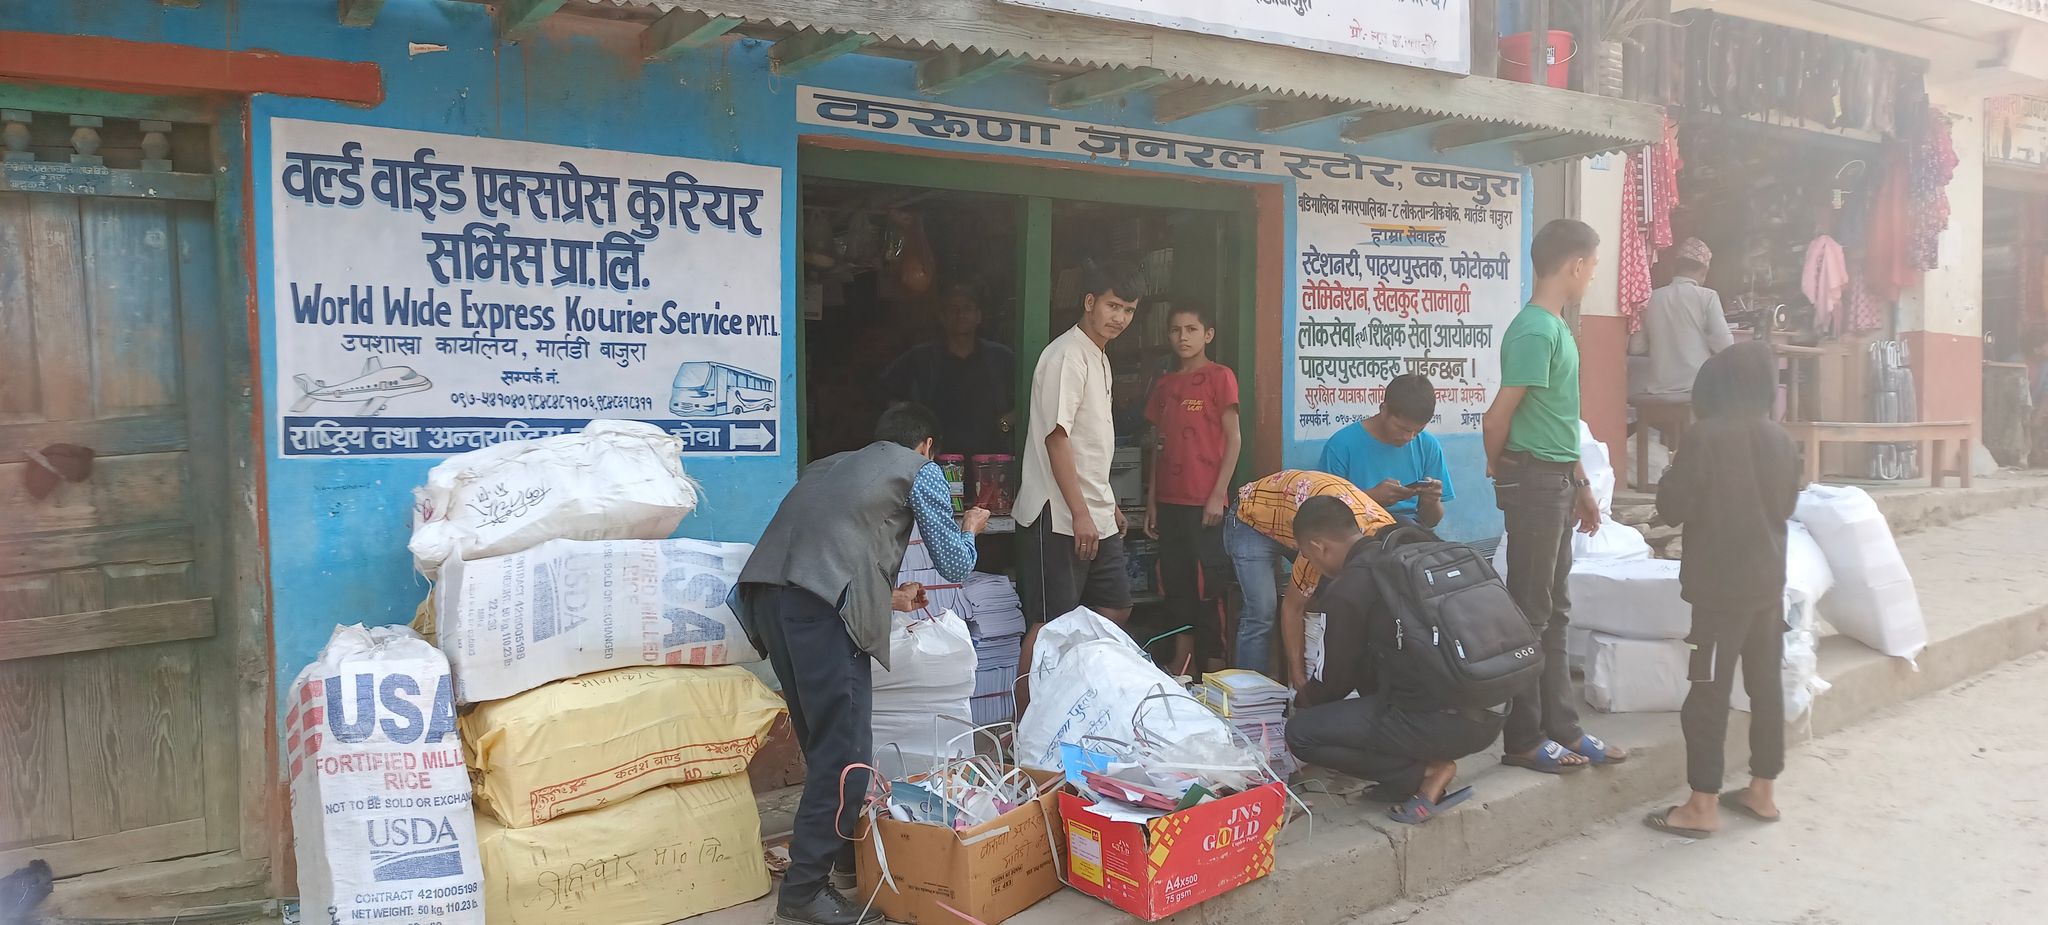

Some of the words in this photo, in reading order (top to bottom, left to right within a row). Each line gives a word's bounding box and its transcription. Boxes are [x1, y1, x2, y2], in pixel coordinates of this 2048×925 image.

[1074, 126, 1264, 170] जनरल
[1280, 154, 1402, 190] स्टोर,
[1411, 166, 1521, 205] बाजुरा
[282, 141, 365, 207] वर्ल्ड
[370, 147, 467, 221] वाईड
[471, 161, 620, 226] एक्सप्रेस
[628, 171, 764, 240] कुरियर
[422, 222, 547, 286] सर्भिस
[1302, 244, 1363, 282] स्टेशनरी,
[1449, 250, 1511, 280] फोटोकपी
[290, 282, 374, 326] World
[383, 286, 451, 328] Wide
[460, 288, 556, 338] Express
[565, 295, 658, 333] Kourier
[659, 300, 742, 336] Service
[1373, 281, 1420, 318] खेलकुद
[1368, 317, 1406, 350] शिक्षक
[1408, 318, 1433, 349] सेवा
[1433, 318, 1493, 349] आयोगका
[340, 334, 421, 357] उपशाखा
[535, 332, 590, 360] मार्तडी
[599, 341, 648, 369] बाजुरा
[500, 367, 543, 386] सम्पर्क
[545, 368, 560, 384] नं.
[1304, 384, 1336, 409] सुरक्षित
[1299, 409, 1321, 428] सम्पर्क
[289, 419, 369, 454] राष्ट्रिय
[371, 427, 421, 450] तथा
[564, 552, 590, 634] USDA
[325, 673, 459, 743] USA
[316, 752, 417, 776] FORTIFIED
[422, 749, 465, 769] MILL
[384, 771, 432, 790] RICE
[325, 802, 346, 814] NOT
[351, 800, 364, 810] TO
[367, 798, 381, 809] BE
[385, 798, 413, 809] SOLD
[416, 797, 431, 808] OR
[434, 792, 472, 806] EXCHAN
[1227, 802, 1262, 825] JNS
[367, 815, 458, 848] USDA
[1203, 819, 1260, 852] GOLD
[351, 908, 371, 919] NET
[418, 906, 429, 916] 50
[445, 899, 472, 913] 110.23
[355, 890, 414, 904] CONTRACT
[418, 882, 478, 900] 4210005198
[1165, 895, 1175, 904] 75
[1176, 889, 1192, 903] gsm
